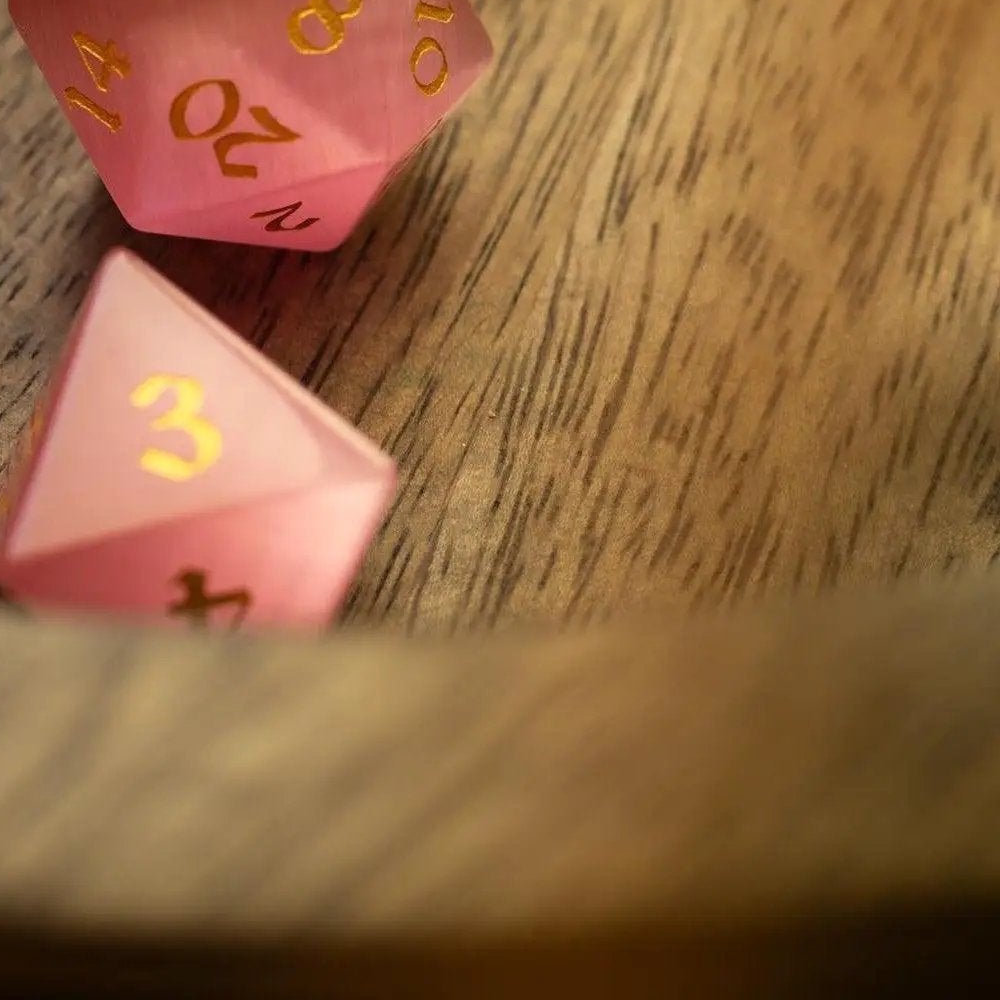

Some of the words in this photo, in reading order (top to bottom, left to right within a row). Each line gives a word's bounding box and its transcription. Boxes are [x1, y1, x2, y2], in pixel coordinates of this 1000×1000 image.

[64, 30, 132, 134] 14
[409, 0, 456, 98] 10
[169, 78, 303, 179] 20
[130, 374, 223, 483] 3
